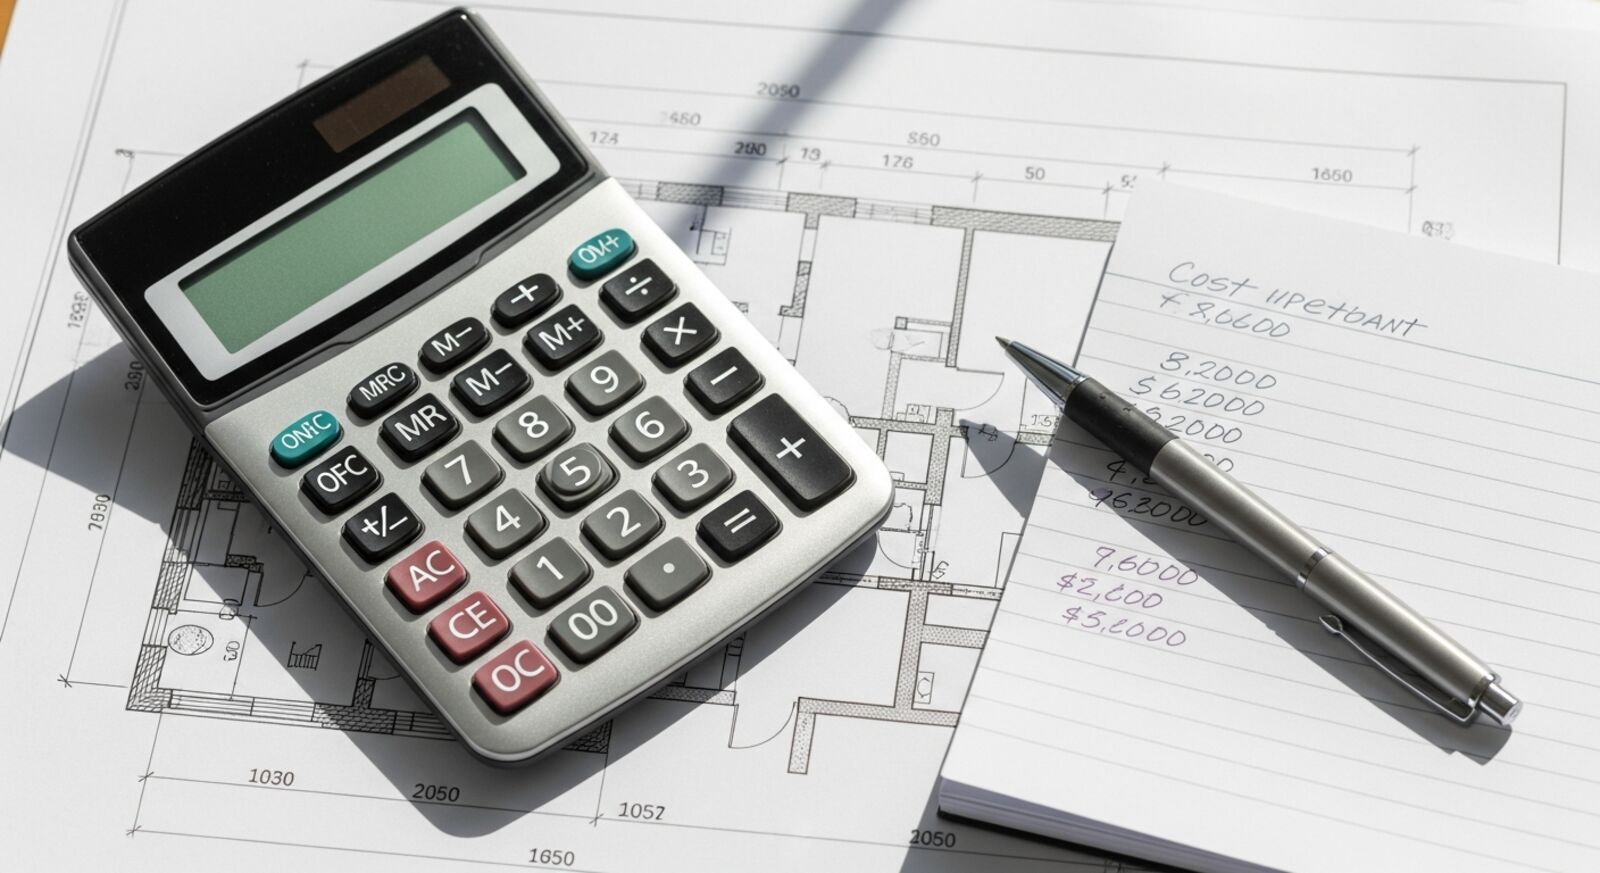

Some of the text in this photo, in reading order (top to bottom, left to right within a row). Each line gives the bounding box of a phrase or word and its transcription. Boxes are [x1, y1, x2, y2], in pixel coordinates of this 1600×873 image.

[1024, 165, 1046, 181] 50
[538, 315, 585, 351] M+
[358, 364, 406, 402] MRC
[590, 365, 620, 394] 9
[394, 403, 447, 442] MR
[518, 411, 549, 439] 8
[635, 410, 665, 439] 6
[316, 453, 368, 494] OFC
[443, 454, 473, 486] 7
[559, 455, 592, 487] 5
[676, 459, 710, 489] 3
[496, 504, 522, 532] 4
[606, 506, 642, 538] 2
[408, 549, 456, 593] AC
[536, 555, 564, 580] 1
[449, 600, 497, 640] CE
[568, 599, 619, 641] 00
[491, 647, 545, 692] OC
[248, 767, 296, 788] 1030
[411, 782, 461, 803] 2050
[909, 829, 957, 849] 2050
[527, 847, 575, 867] 1650
